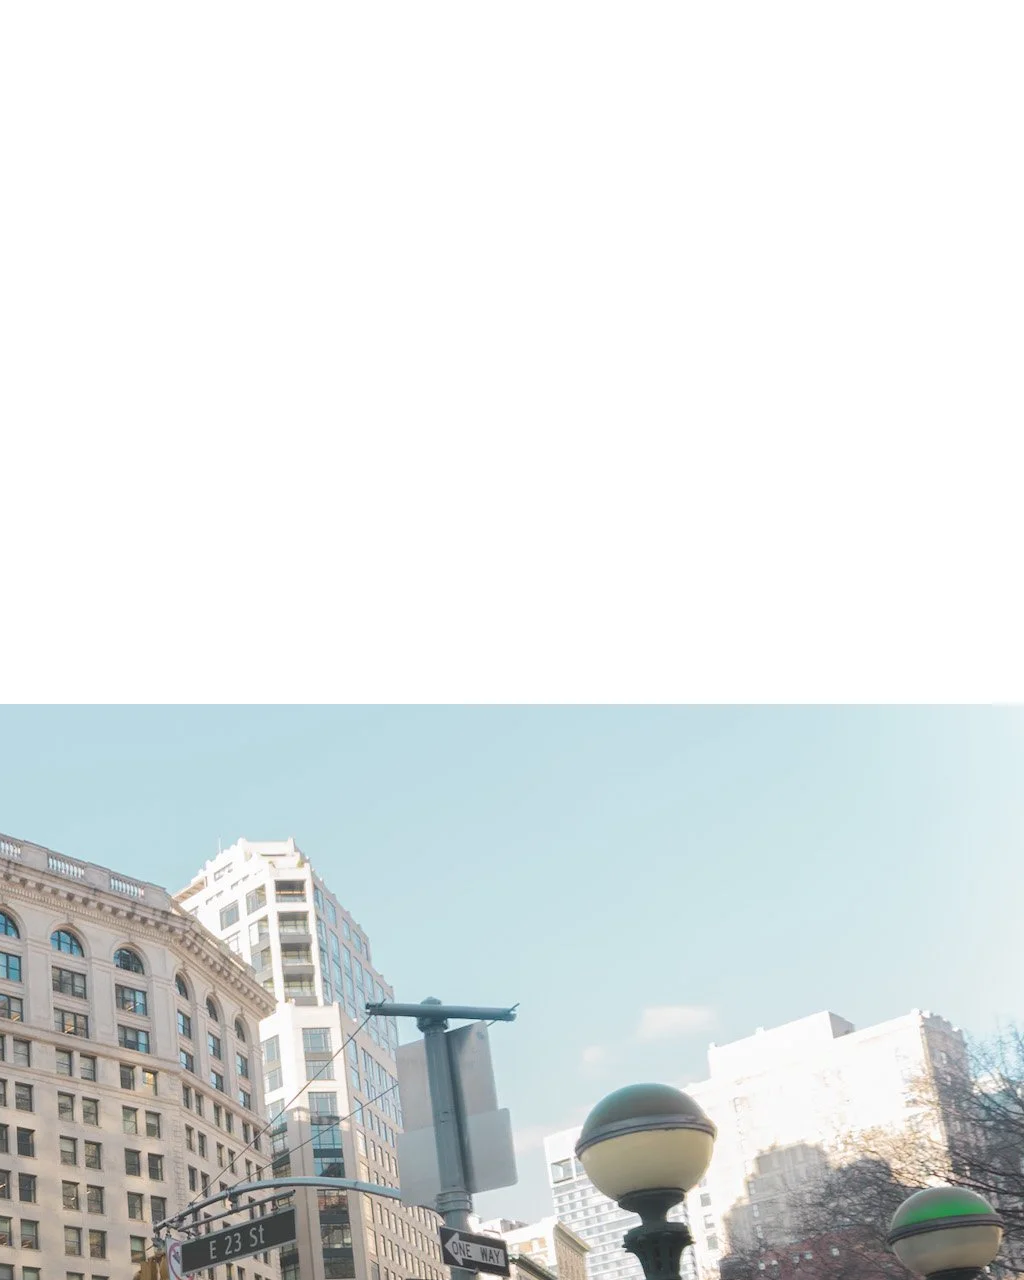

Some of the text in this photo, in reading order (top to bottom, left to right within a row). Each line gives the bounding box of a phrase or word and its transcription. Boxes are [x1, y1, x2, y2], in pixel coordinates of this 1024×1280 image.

[209, 1224, 265, 1260] E 23 St
[451, 1241, 501, 1264] ONE WAY
